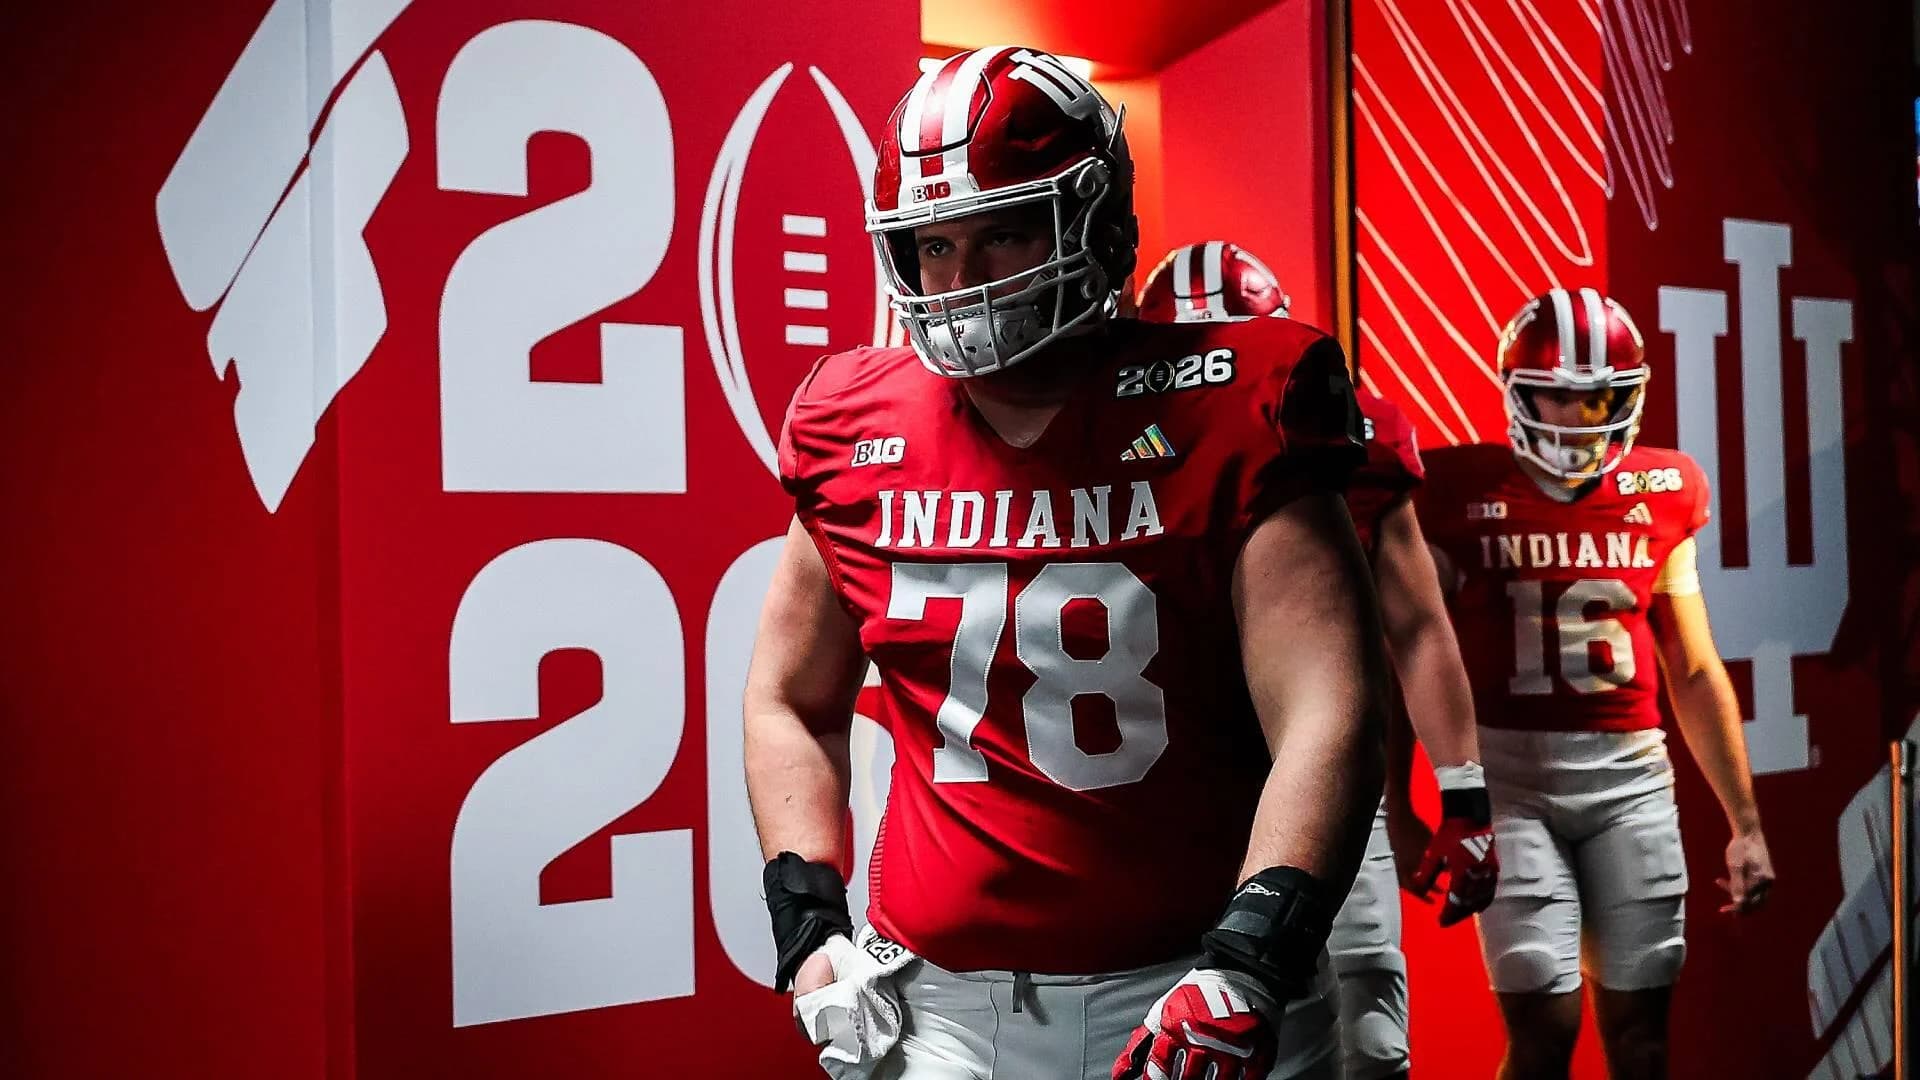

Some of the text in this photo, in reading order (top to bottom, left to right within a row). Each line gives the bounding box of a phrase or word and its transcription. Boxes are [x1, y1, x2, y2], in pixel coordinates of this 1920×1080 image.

[874, 480, 1165, 549] INDIANA
[1480, 532, 1655, 569] INDIANA
[886, 561, 1169, 792] 78
[1506, 578, 1638, 695] 16
